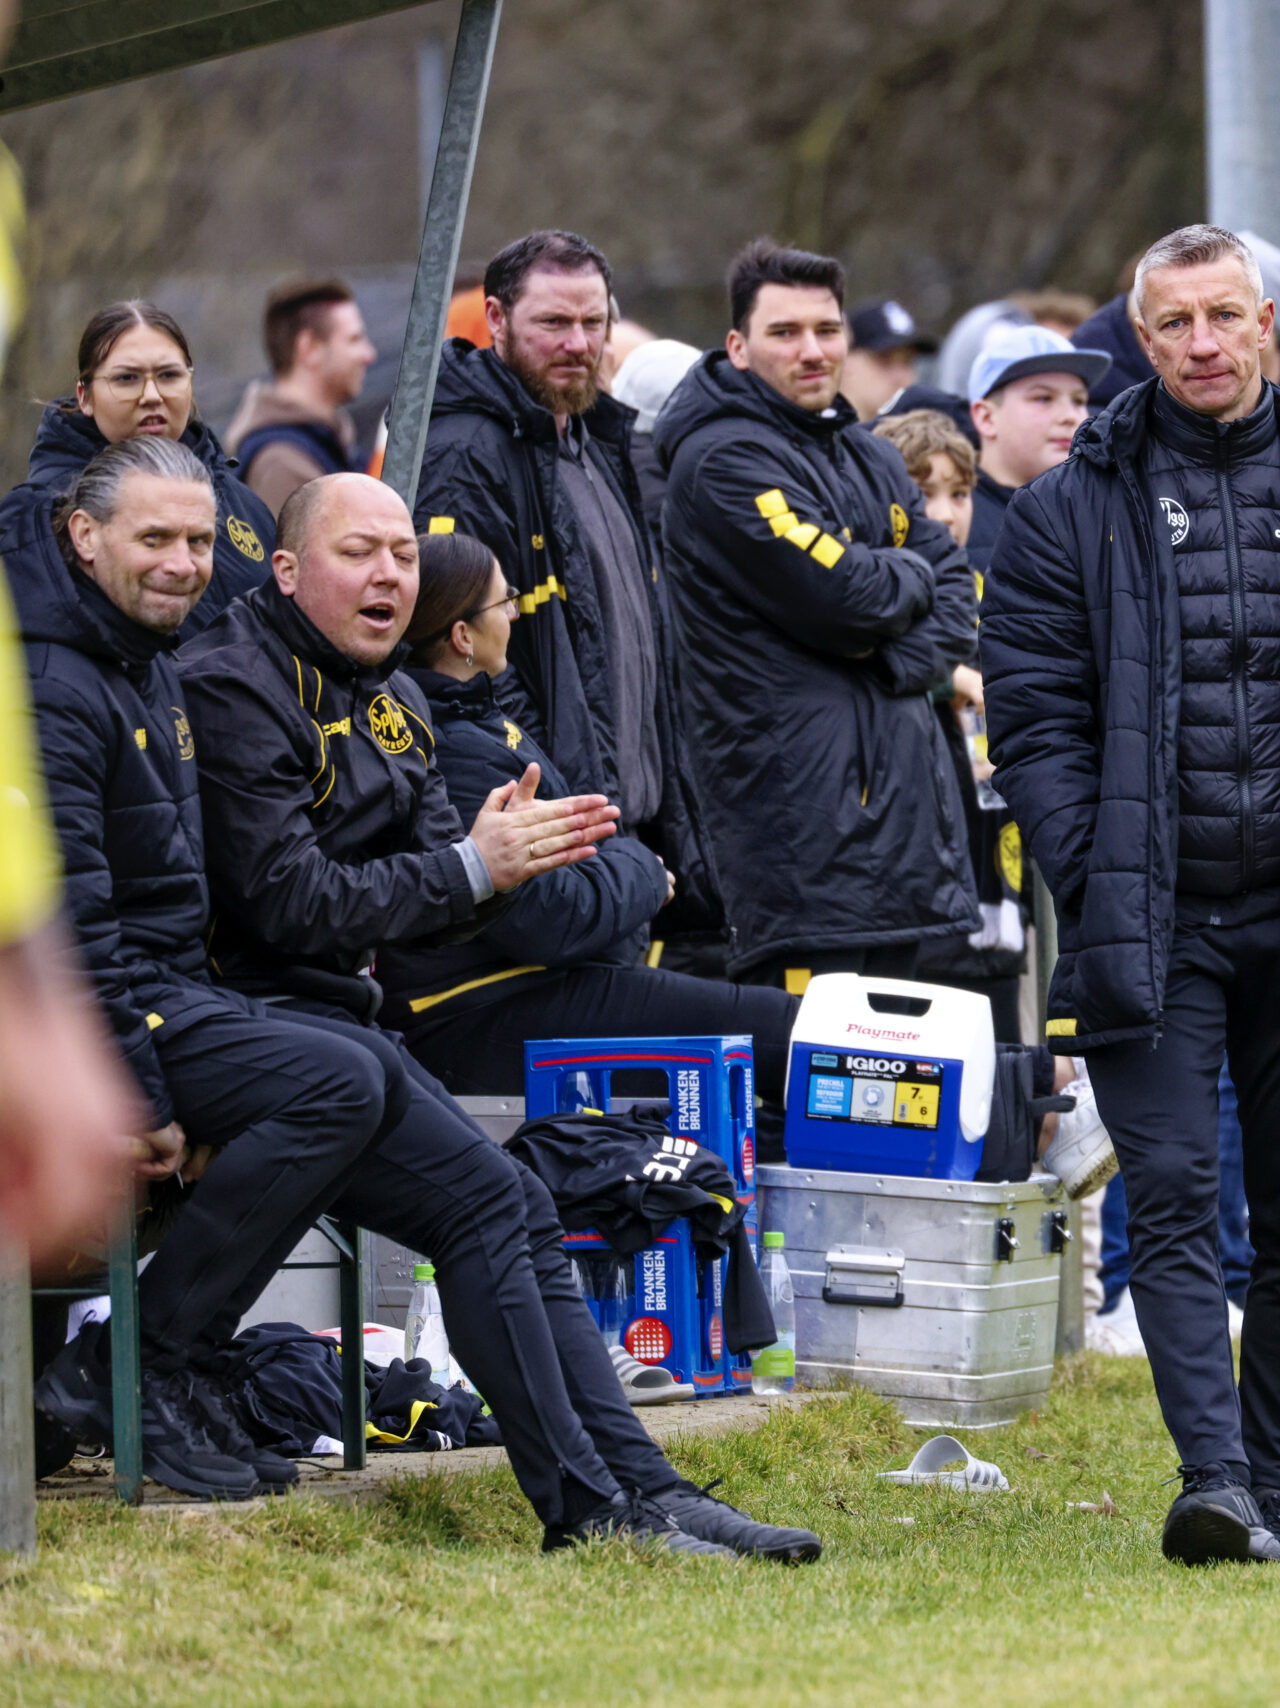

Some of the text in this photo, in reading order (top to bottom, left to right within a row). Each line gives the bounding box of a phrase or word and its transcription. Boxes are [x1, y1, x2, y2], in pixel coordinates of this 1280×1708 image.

[846, 1023, 921, 1041] Playmate
[846, 1055, 907, 1074] IGLOO
[677, 1070, 689, 1130] FRANKEN
[689, 1070, 701, 1130] BRUNNEN
[911, 1087, 920, 1099] 7
[920, 1106, 927, 1115] 6
[643, 1250, 655, 1311] FRANKEN
[655, 1250, 667, 1311] BRUNNEN
